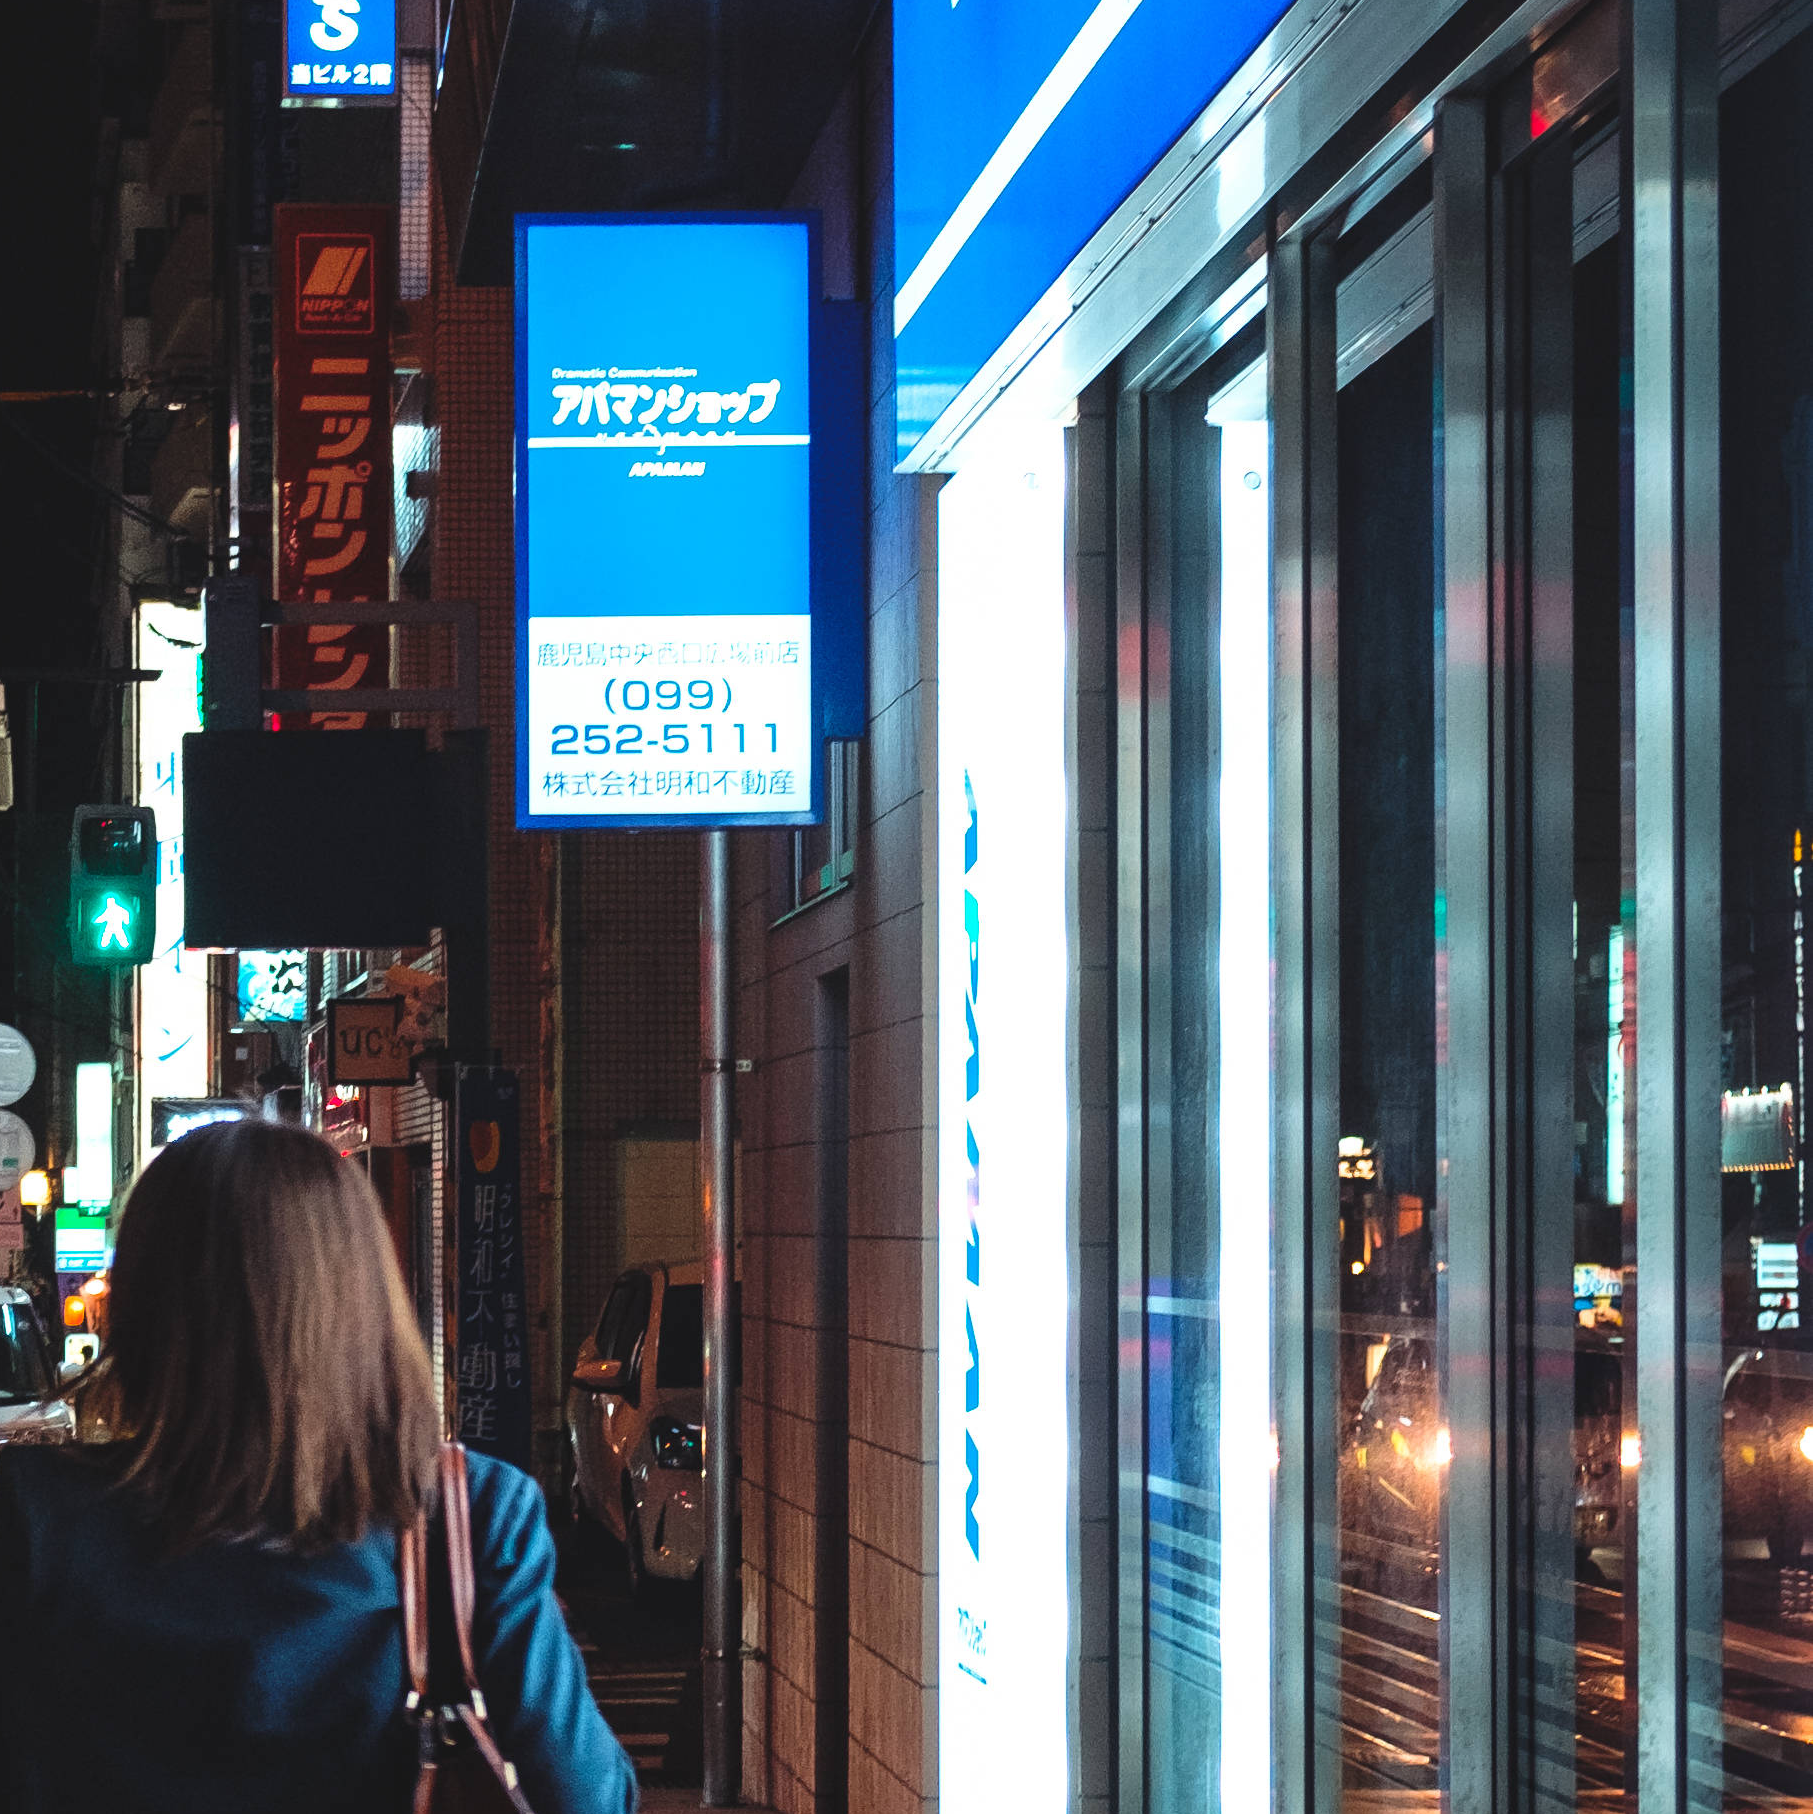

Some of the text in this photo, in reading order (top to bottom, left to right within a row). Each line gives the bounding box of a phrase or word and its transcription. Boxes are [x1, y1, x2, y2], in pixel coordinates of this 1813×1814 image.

[552, 379, 781, 426] アパマンショップ
[604, 678, 732, 714] (099)
[551, 723, 777, 755] 252-5111
[542, 769, 797, 798] 株式会社明和不動産
[458, 1184, 499, 1442] 明和不動産
